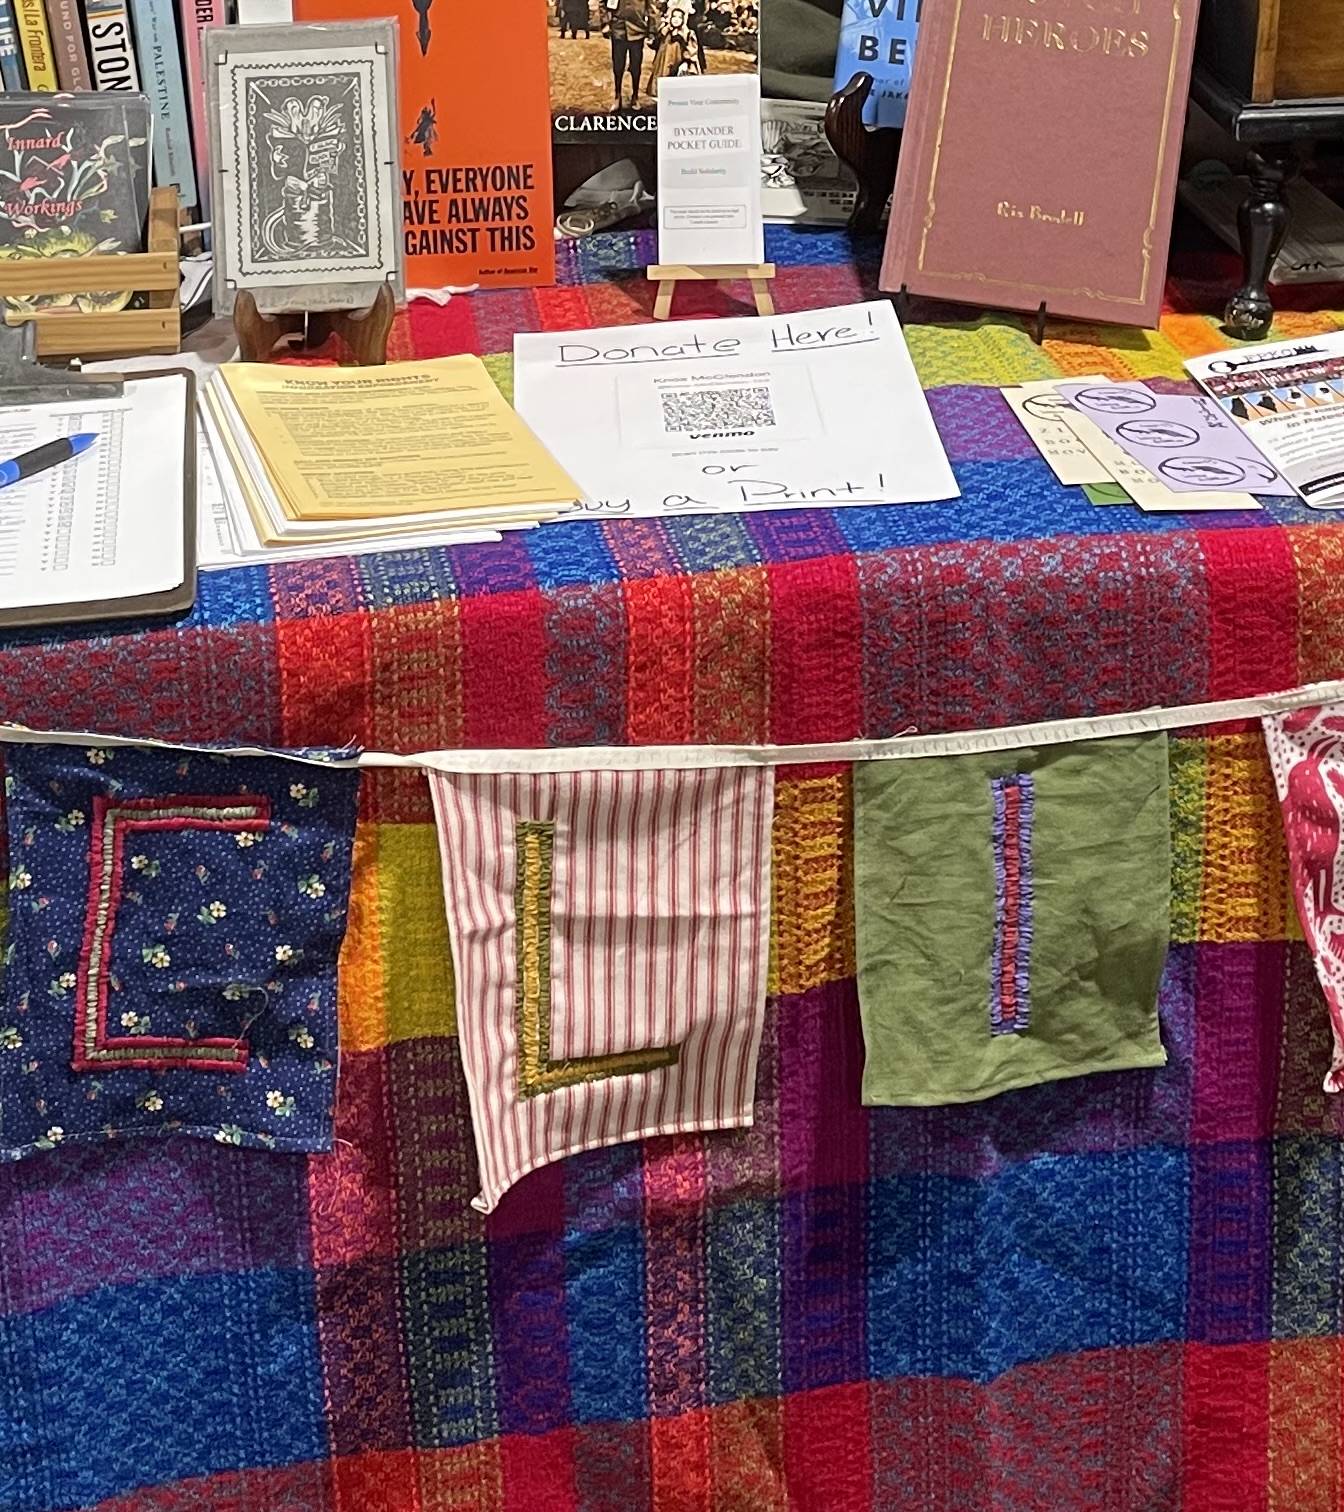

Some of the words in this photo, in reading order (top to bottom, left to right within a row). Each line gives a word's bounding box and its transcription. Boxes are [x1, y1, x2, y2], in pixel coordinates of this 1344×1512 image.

[981, 13, 1150, 58] HEROES
[27, 29, 47, 73] Frontera
[65, 34, 78, 63] FOR
[152, 44, 172, 121] PALESTINE
[554, 115, 657, 132] CLARENCE
[673, 125, 735, 137] BYSTANDER
[6, 131, 65, 152] Innard
[667, 139, 707, 151] POCKET
[708, 138, 742, 150] GUIDE
[425, 164, 535, 195] EVERYONE
[5, 198, 84, 218] Workings
[447, 195, 529, 225] ALWAYS
[485, 225, 536, 252] THIS
[557, 333, 741, 364] Donate
[771, 310, 874, 349] Here!
[284, 377, 328, 387] KNOW
[332, 376, 372, 386] YOUR
[375, 374, 432, 384] RIGHTS
[688, 430, 756, 441] venmo
[701, 463, 758, 476] or
